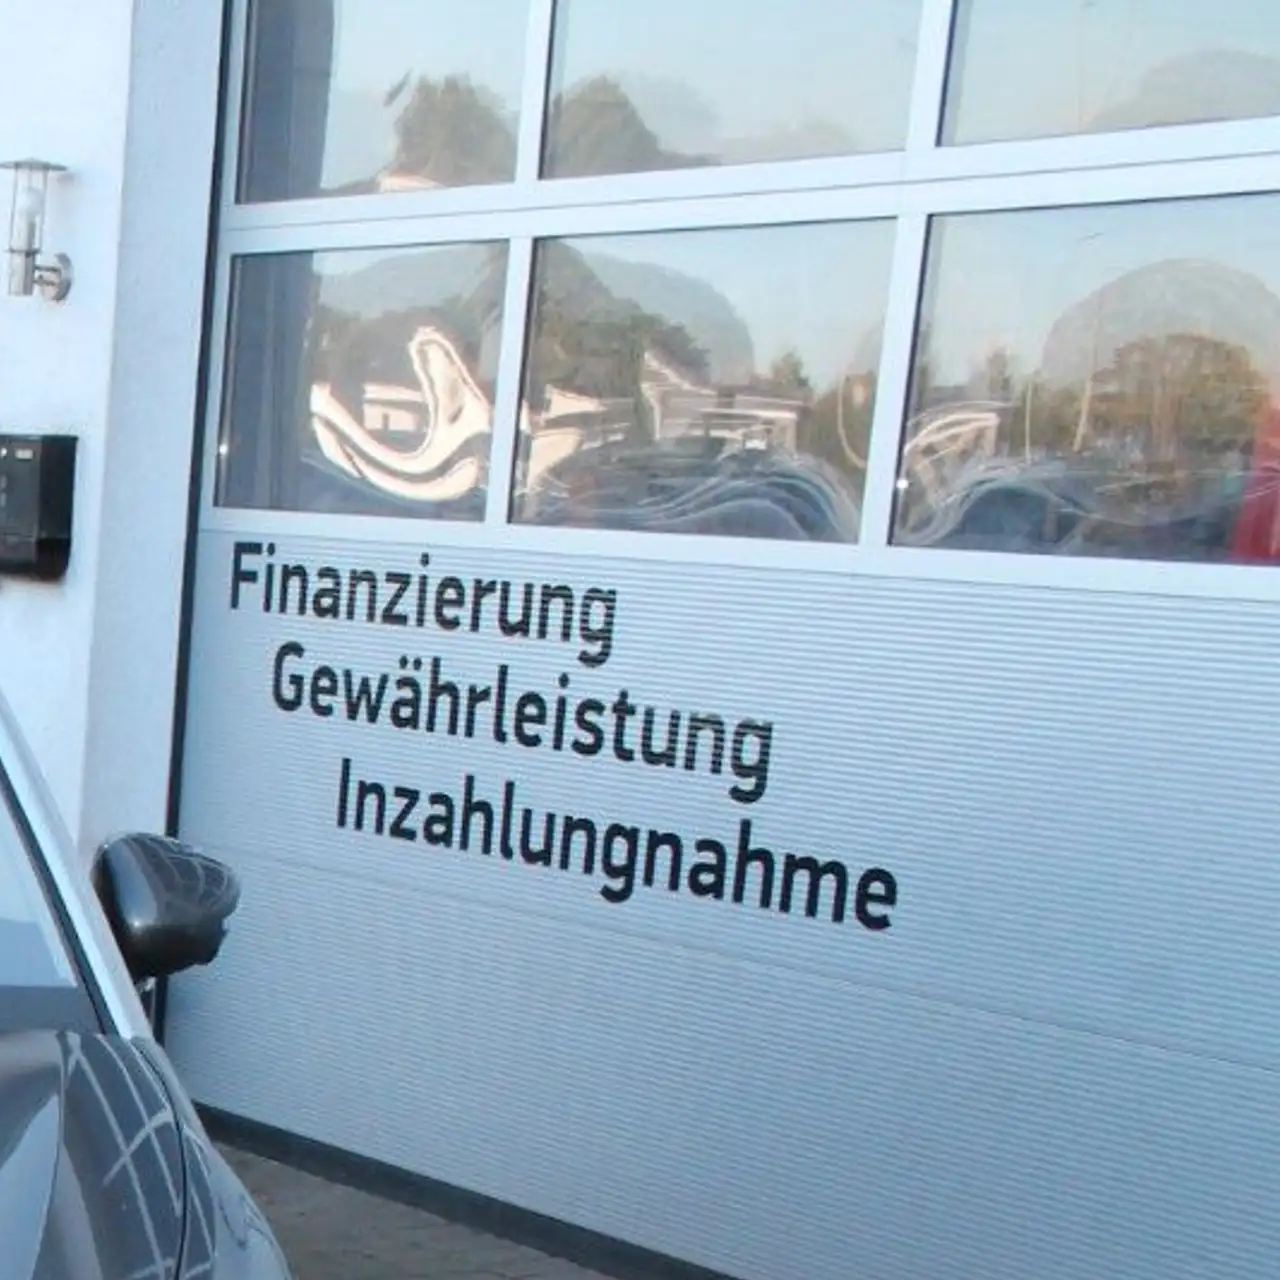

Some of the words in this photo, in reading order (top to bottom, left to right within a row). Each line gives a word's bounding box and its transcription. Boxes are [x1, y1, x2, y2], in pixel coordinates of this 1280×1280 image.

[230, 541, 617, 667] Finanzierung
[272, 641, 773, 805] Gewährleistung
[336, 758, 899, 932] Inzahlungnahme
